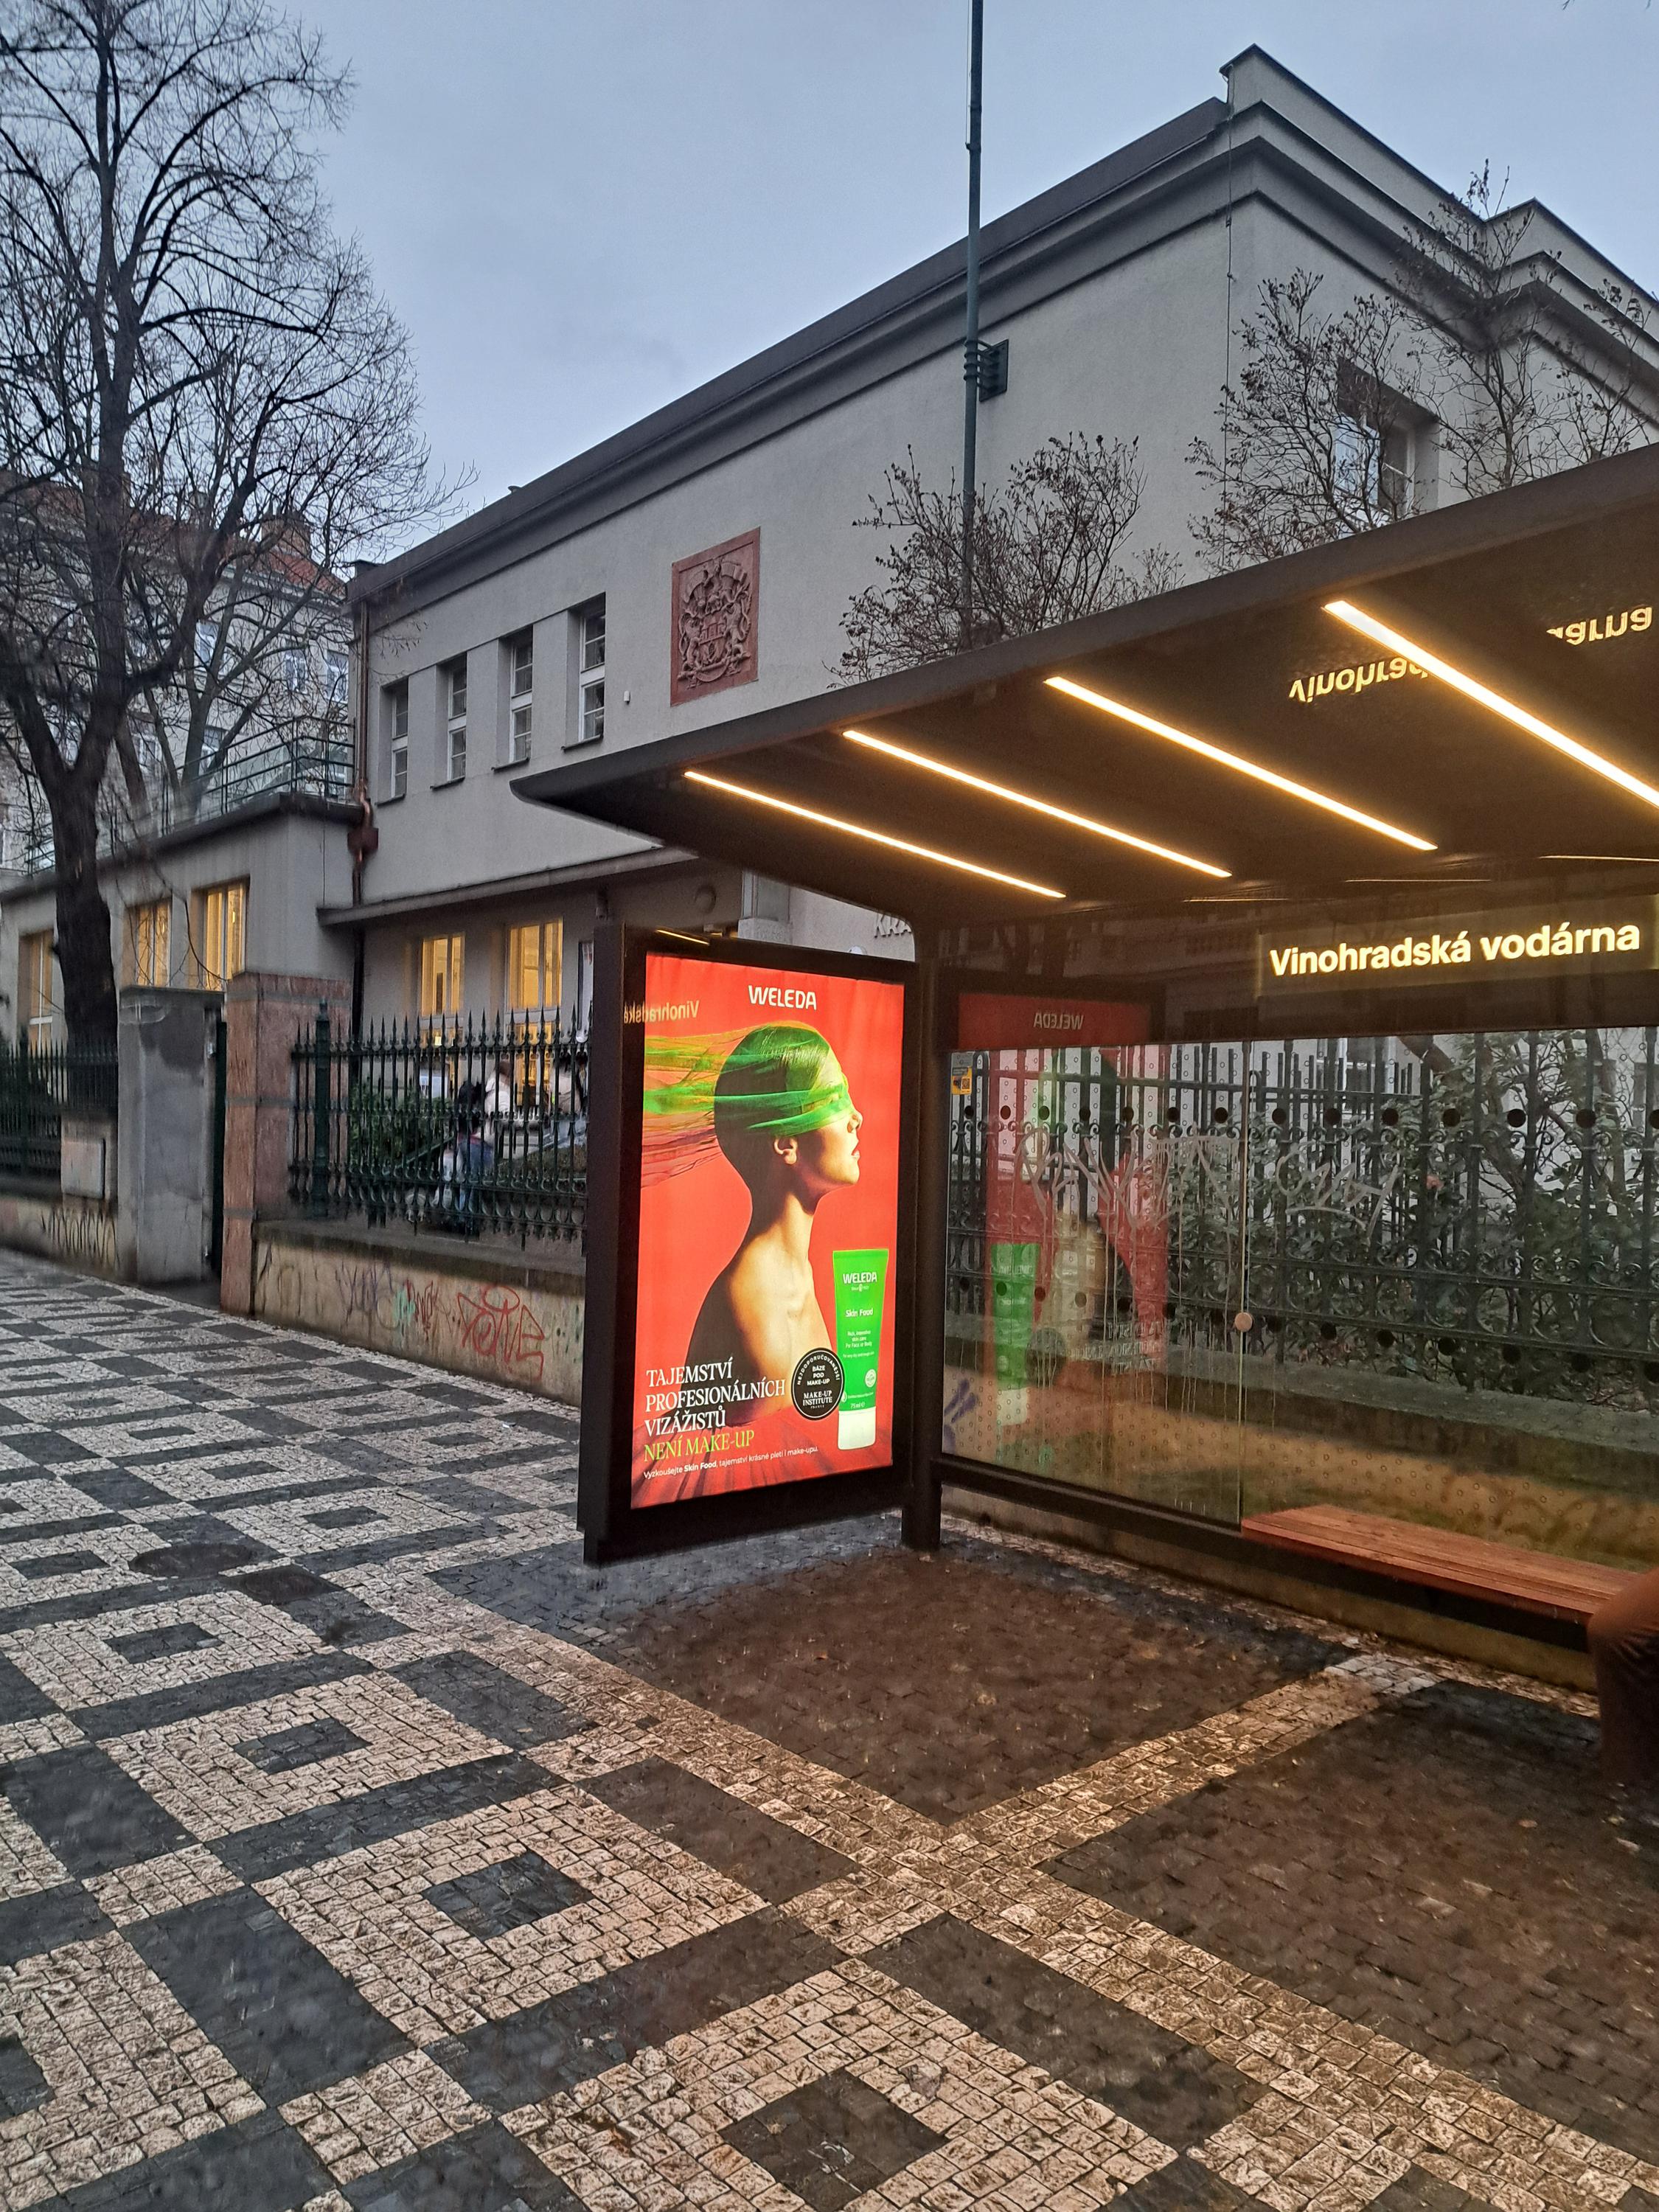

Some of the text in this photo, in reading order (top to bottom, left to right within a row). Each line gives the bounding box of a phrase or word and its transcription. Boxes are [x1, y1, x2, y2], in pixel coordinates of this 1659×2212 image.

[1269, 922, 1641, 976] Vinohradská vodárna
[748, 984, 817, 1011] WELEDA
[842, 1271, 877, 1284] WELEDA
[845, 1307, 874, 1318] Skin Food
[646, 1356, 733, 1388] TAJEMSTVÍ
[812, 1364, 826, 1372] BÁZE
[644, 1377, 786, 1413] PROFESIONÁLNÍCH
[803, 1390, 832, 1399] MAKE-UP
[807, 1378, 830, 1386] MAKE-UP
[802, 1397, 833, 1407] INSTITUTE
[644, 1405, 726, 1437] VIZÁŽISTŮ
[643, 1429, 755, 1462] NENÍ MAKE-UP
[643, 1466, 683, 1479] Vyzkoušejte
[684, 1463, 699, 1472] Skin
[700, 1460, 718, 1470] Food,
[719, 1455, 748, 1467] tajemství
[748, 1453, 768, 1462] krásné
